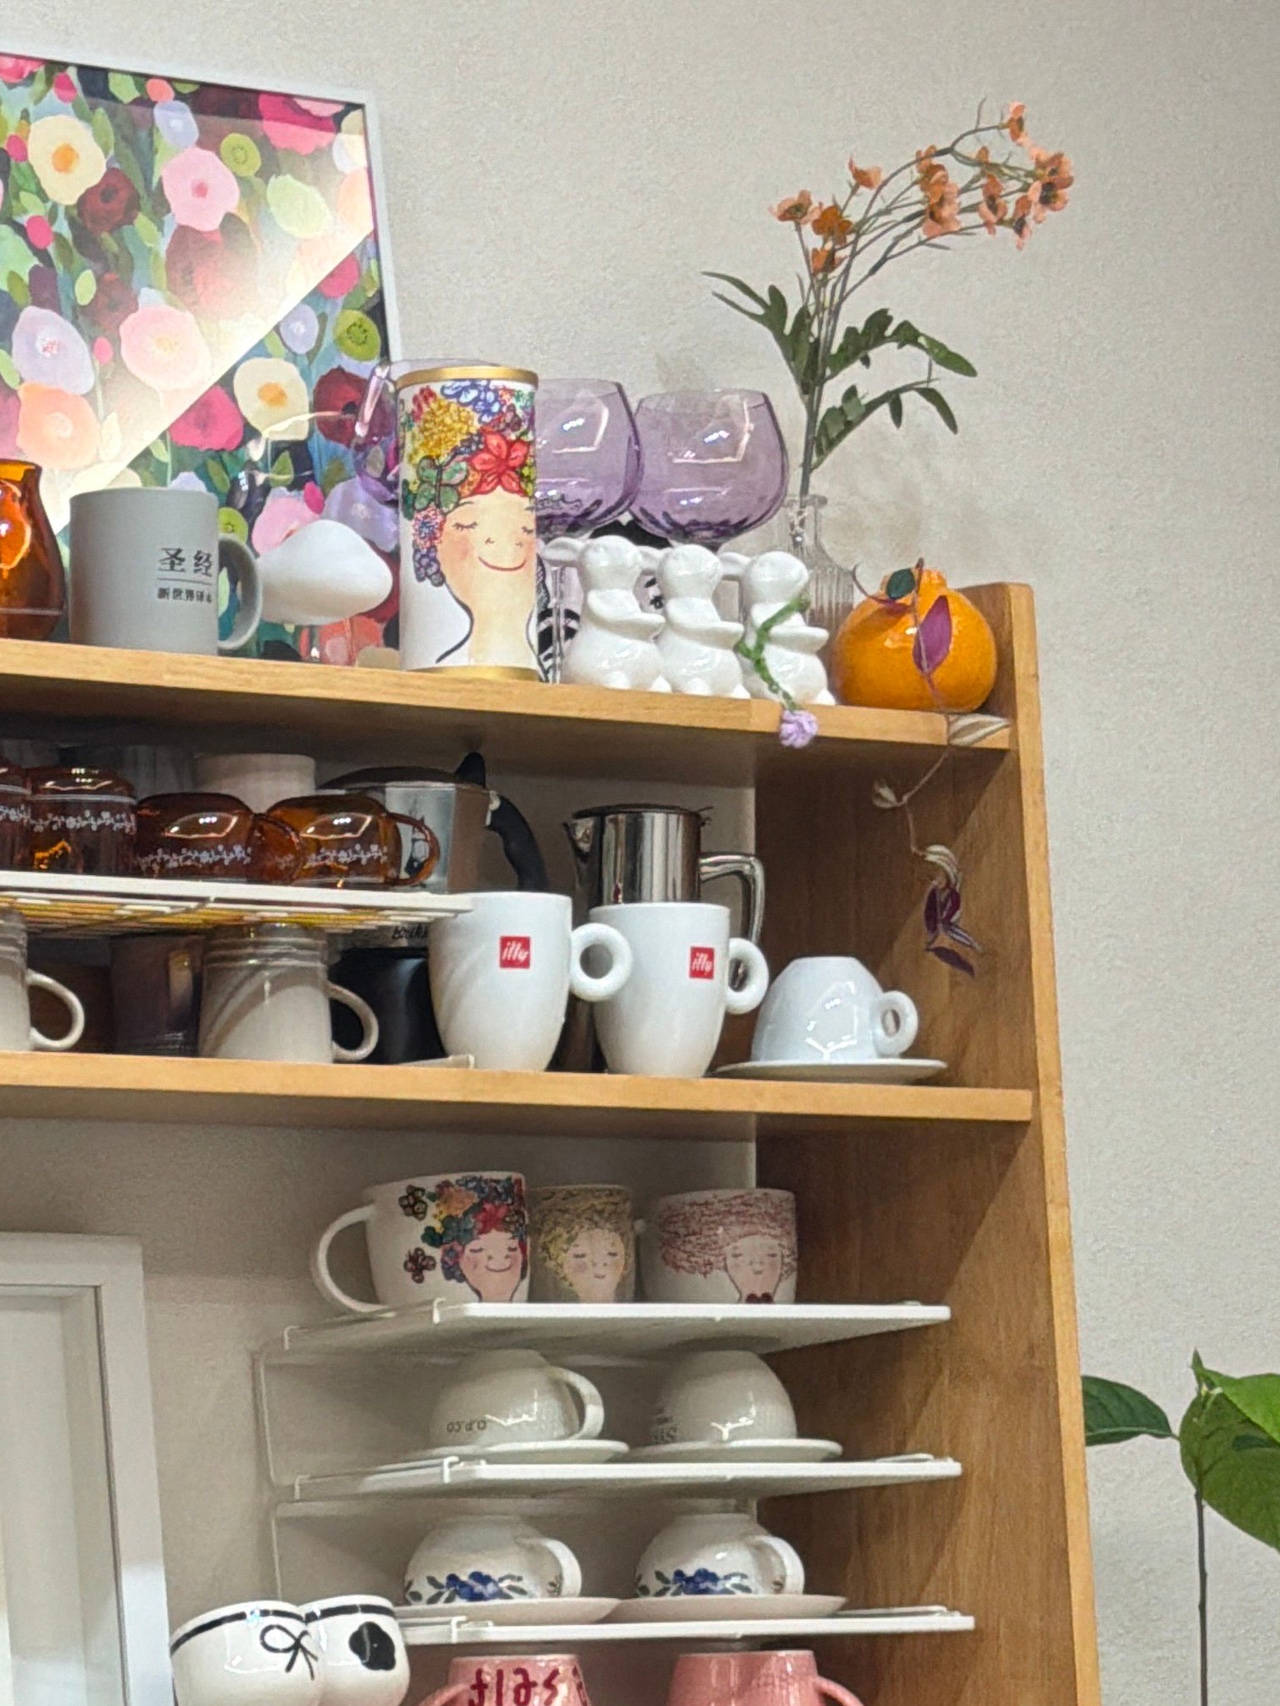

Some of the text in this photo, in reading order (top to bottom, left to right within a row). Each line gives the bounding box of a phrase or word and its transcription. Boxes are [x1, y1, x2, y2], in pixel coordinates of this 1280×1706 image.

[158, 547, 212, 577] 圣经
[502, 940, 528, 963] illy
[691, 952, 713, 976] illy
